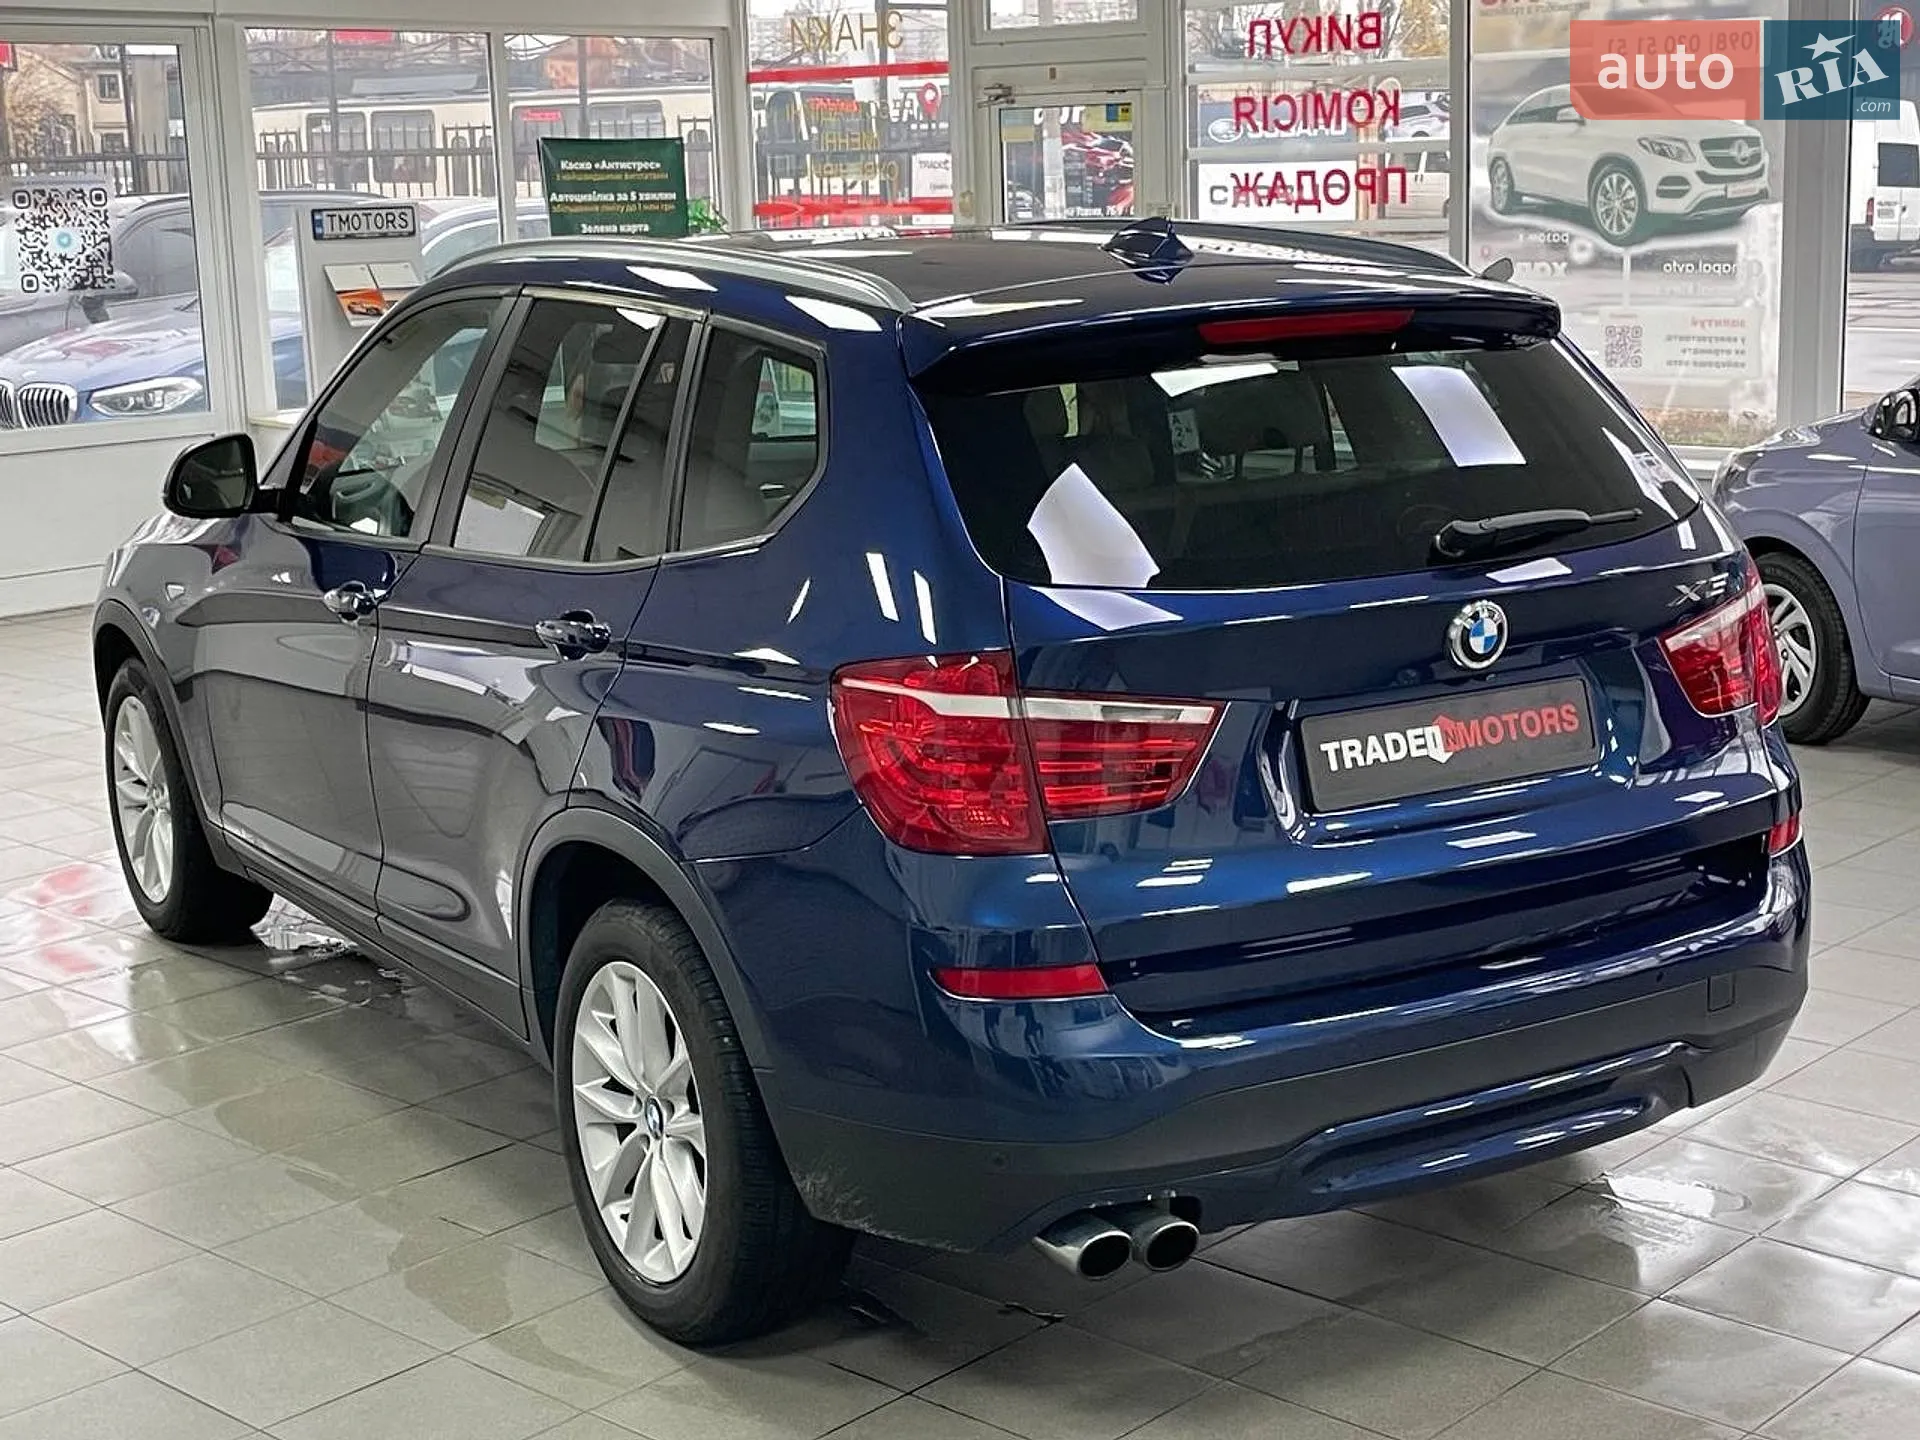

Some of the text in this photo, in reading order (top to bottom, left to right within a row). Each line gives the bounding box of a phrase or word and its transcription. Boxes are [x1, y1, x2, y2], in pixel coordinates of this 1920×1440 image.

[561, 160, 592, 170] Каско
[326, 212, 409, 232] TMOTORS
[581, 223, 649, 233] Зелена карта
